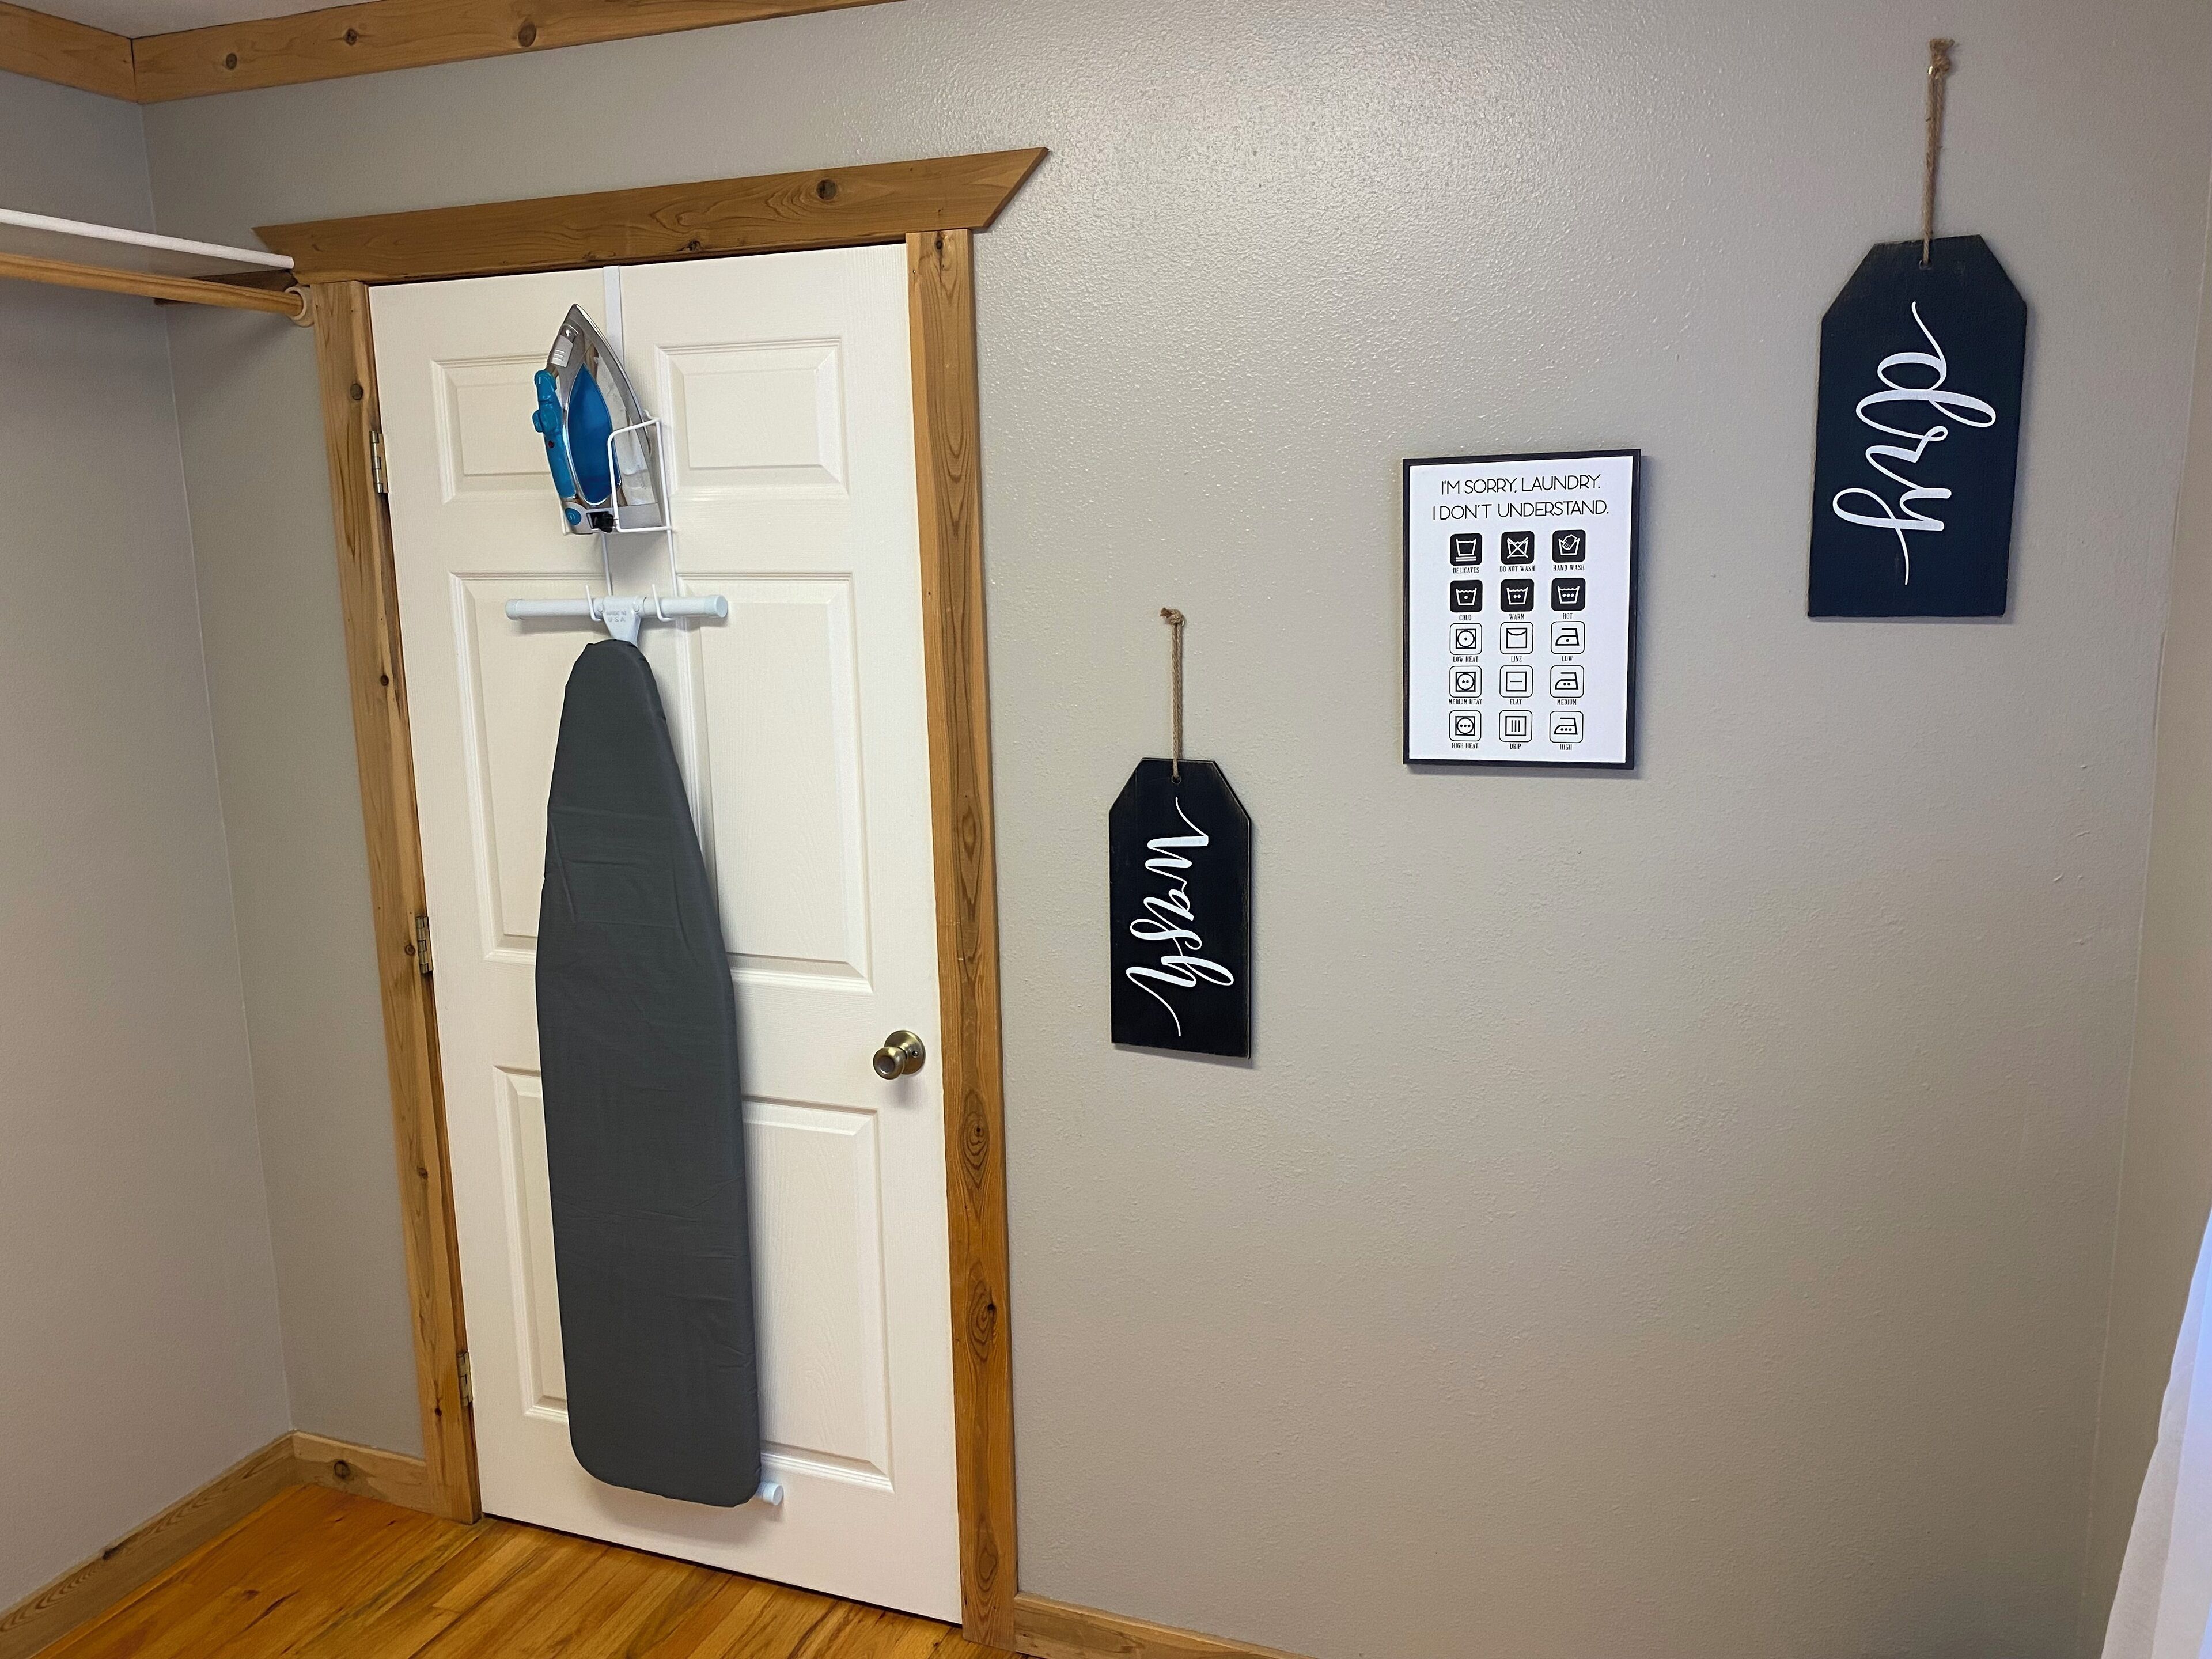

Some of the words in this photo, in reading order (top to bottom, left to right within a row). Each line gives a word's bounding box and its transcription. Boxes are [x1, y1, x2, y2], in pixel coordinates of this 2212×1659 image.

[1441, 480, 1460, 495] I'M
[1464, 477, 1517, 494] SORRY,
[1521, 474, 1601, 492] LAUNDRY.
[1440, 503, 1493, 520] DON'T
[1498, 499, 1609, 518] UNDERSTAND.
